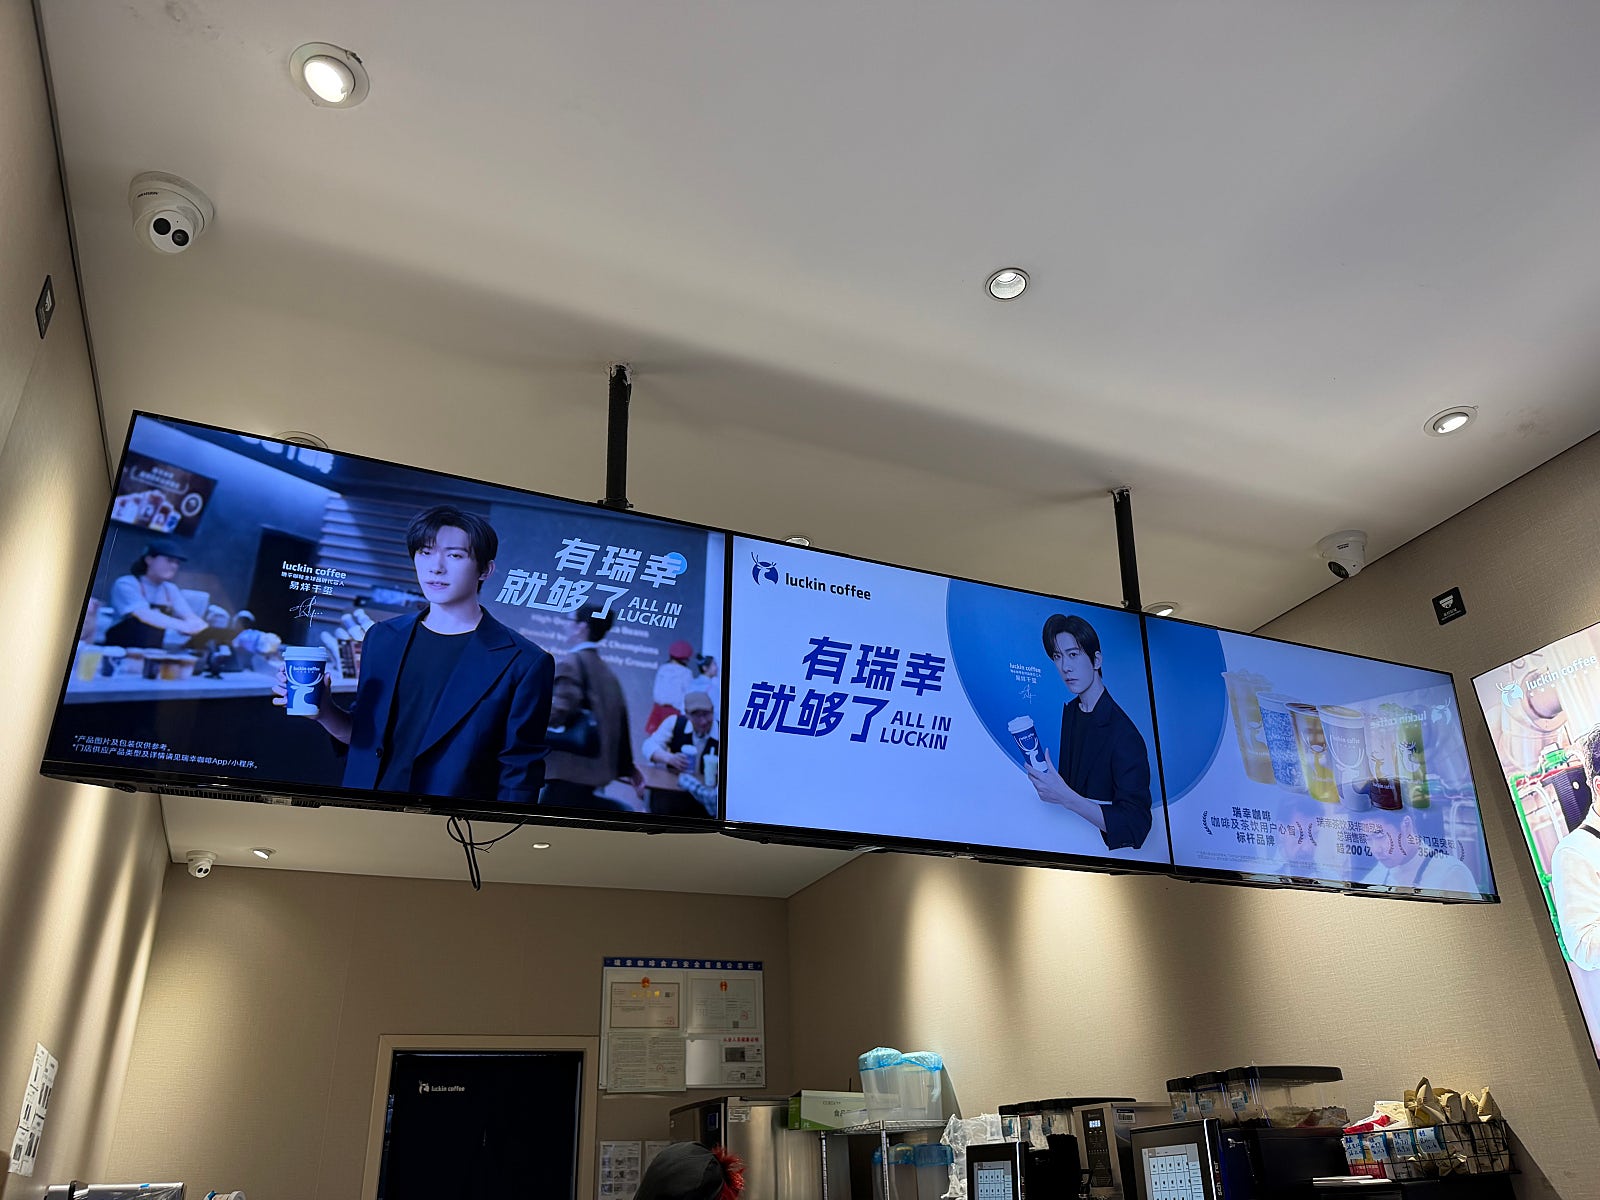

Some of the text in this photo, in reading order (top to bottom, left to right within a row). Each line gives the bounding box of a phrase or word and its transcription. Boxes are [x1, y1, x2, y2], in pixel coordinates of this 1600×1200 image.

[282, 561, 346, 579] luckin coffee
[555, 537, 682, 588] 有瑞幸
[289, 581, 333, 595] 易烊千玺
[495, 568, 629, 619] 就够了
[785, 573, 871, 600] luckin coffee
[628, 597, 682, 615] ALL IN
[617, 608, 678, 629] LUCKIN
[802, 636, 946, 696] 有瑞幸
[1525, 671, 1559, 690] luckin
[1561, 656, 1597, 676] coffee
[739, 681, 890, 743] 就够了
[891, 710, 952, 732] ALL IN
[879, 727, 948, 750] LUCKIN
[1232, 806, 1271, 821] 瑞幸咖啡
[1210, 816, 1295, 836] 咖啡及茶饮用户心智
[1236, 831, 1275, 846] 标杆品牌
